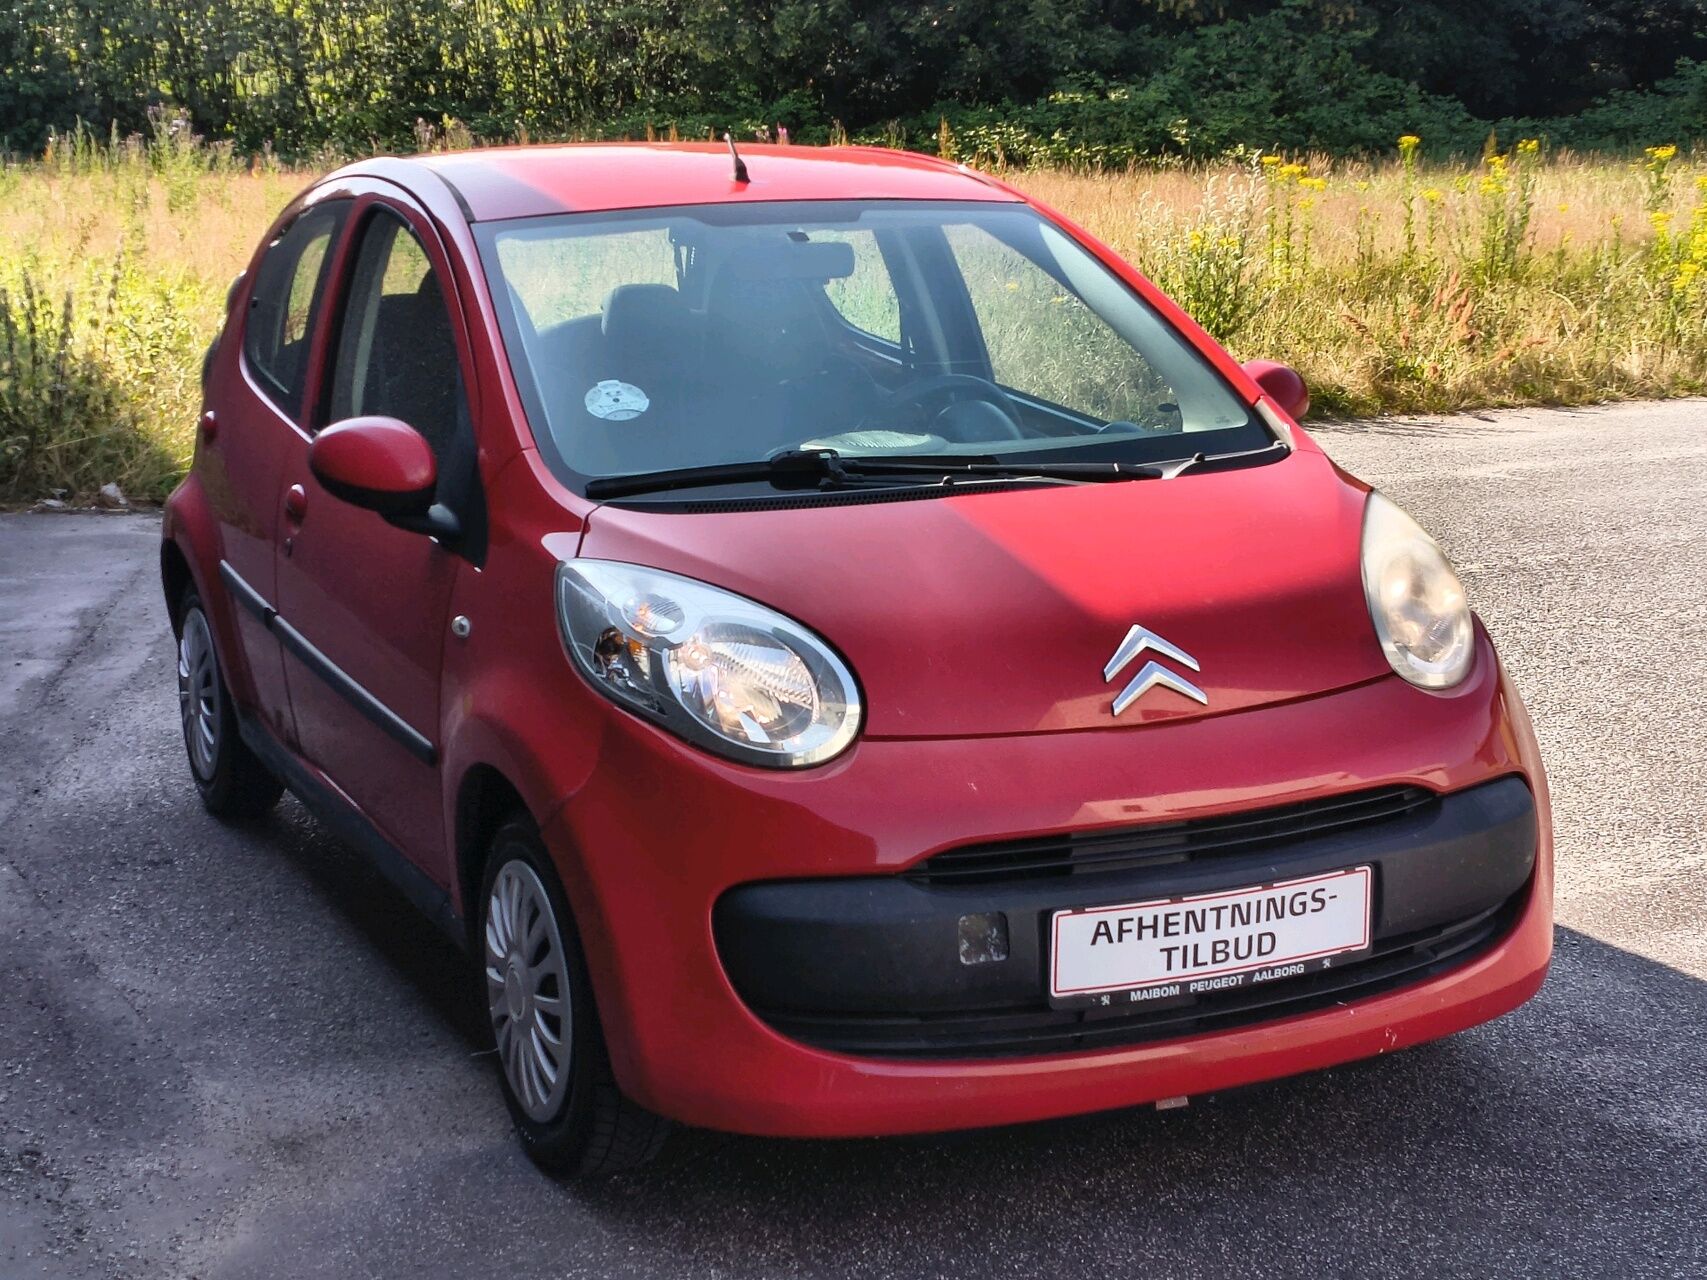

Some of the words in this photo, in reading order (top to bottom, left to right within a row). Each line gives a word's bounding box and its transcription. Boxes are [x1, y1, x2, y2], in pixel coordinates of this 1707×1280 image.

[1091, 887, 1337, 946] AFHENTNINGS-
[1160, 931, 1276, 971] TILBUD
[1130, 985, 1180, 1002] MAIBOM
[1190, 975, 1244, 993] PEUGEOT
[1252, 964, 1305, 982] AALBORG
